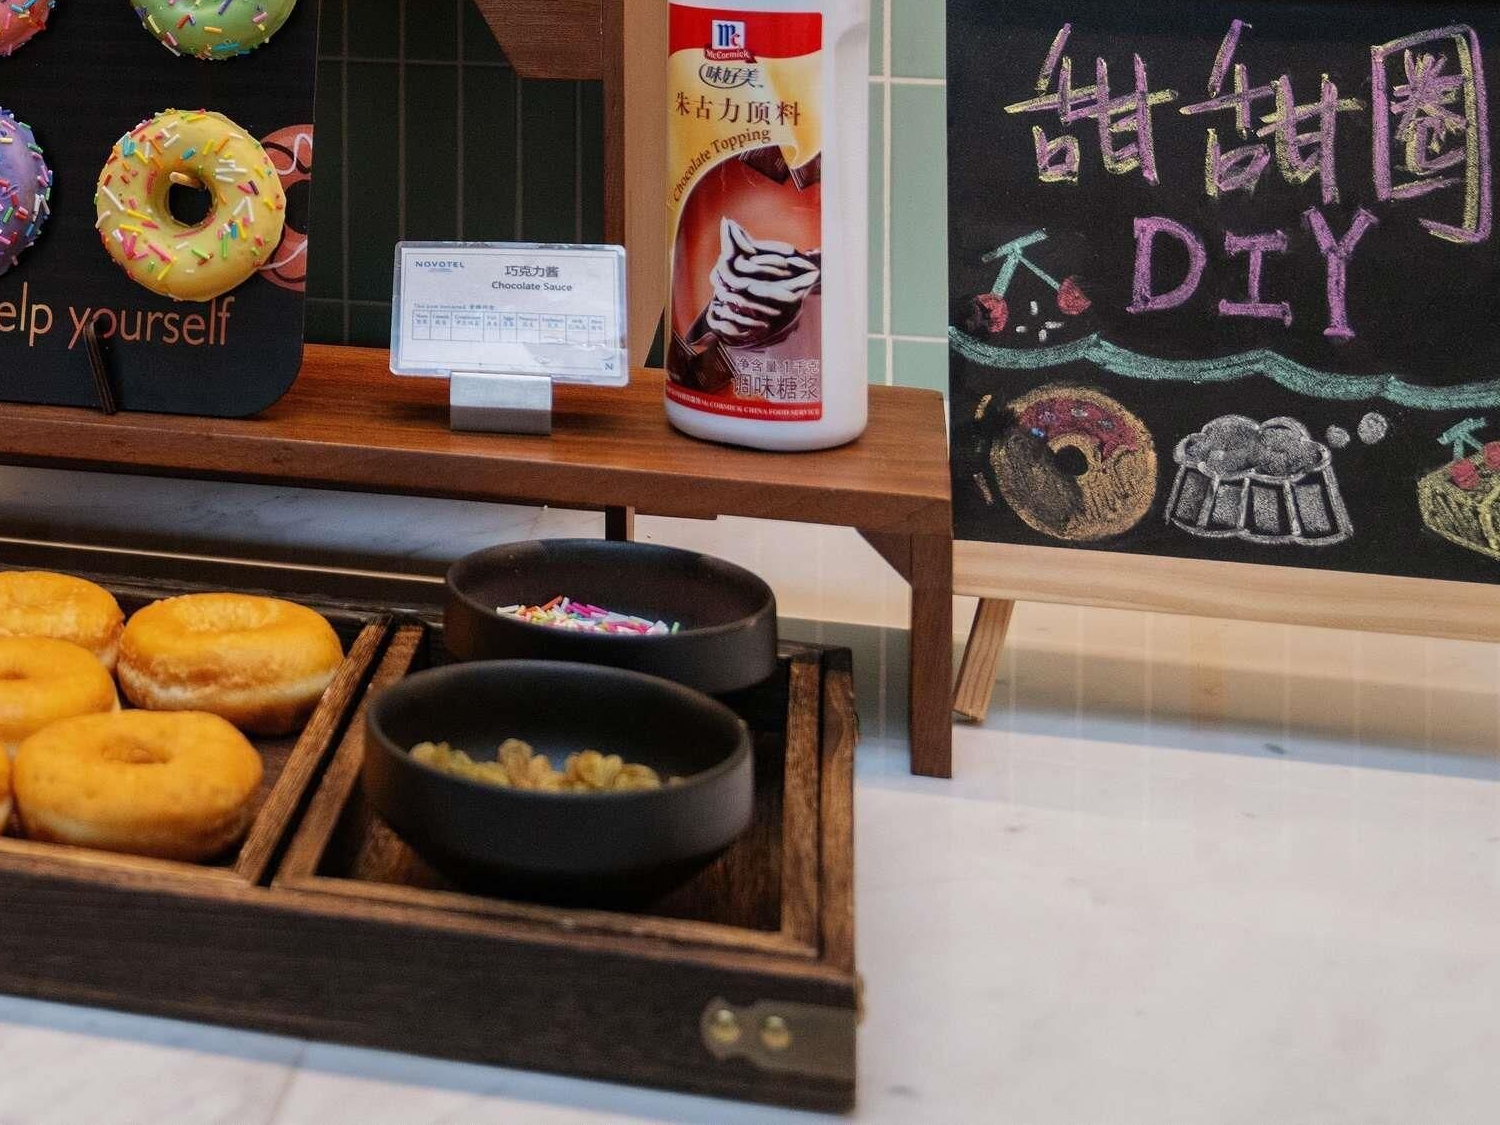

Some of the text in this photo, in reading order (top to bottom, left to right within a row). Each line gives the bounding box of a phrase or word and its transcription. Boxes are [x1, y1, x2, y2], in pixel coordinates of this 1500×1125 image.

[706, 49, 750, 61] McCormick
[704, 66, 760, 88] 味好美
[675, 91, 801, 126] 朱古力顶料
[1004, 19, 1491, 244] 甜甜圈
[673, 128, 772, 203] Chocolate Topping
[414, 260, 466, 269] NOVOTEL
[503, 265, 560, 279] 巧克力酱
[1125, 206, 1380, 342] DIY
[491, 280, 573, 292] Chocolate Sauce
[67, 295, 236, 350] yourself
[733, 373, 818, 400] 调味糖浆
